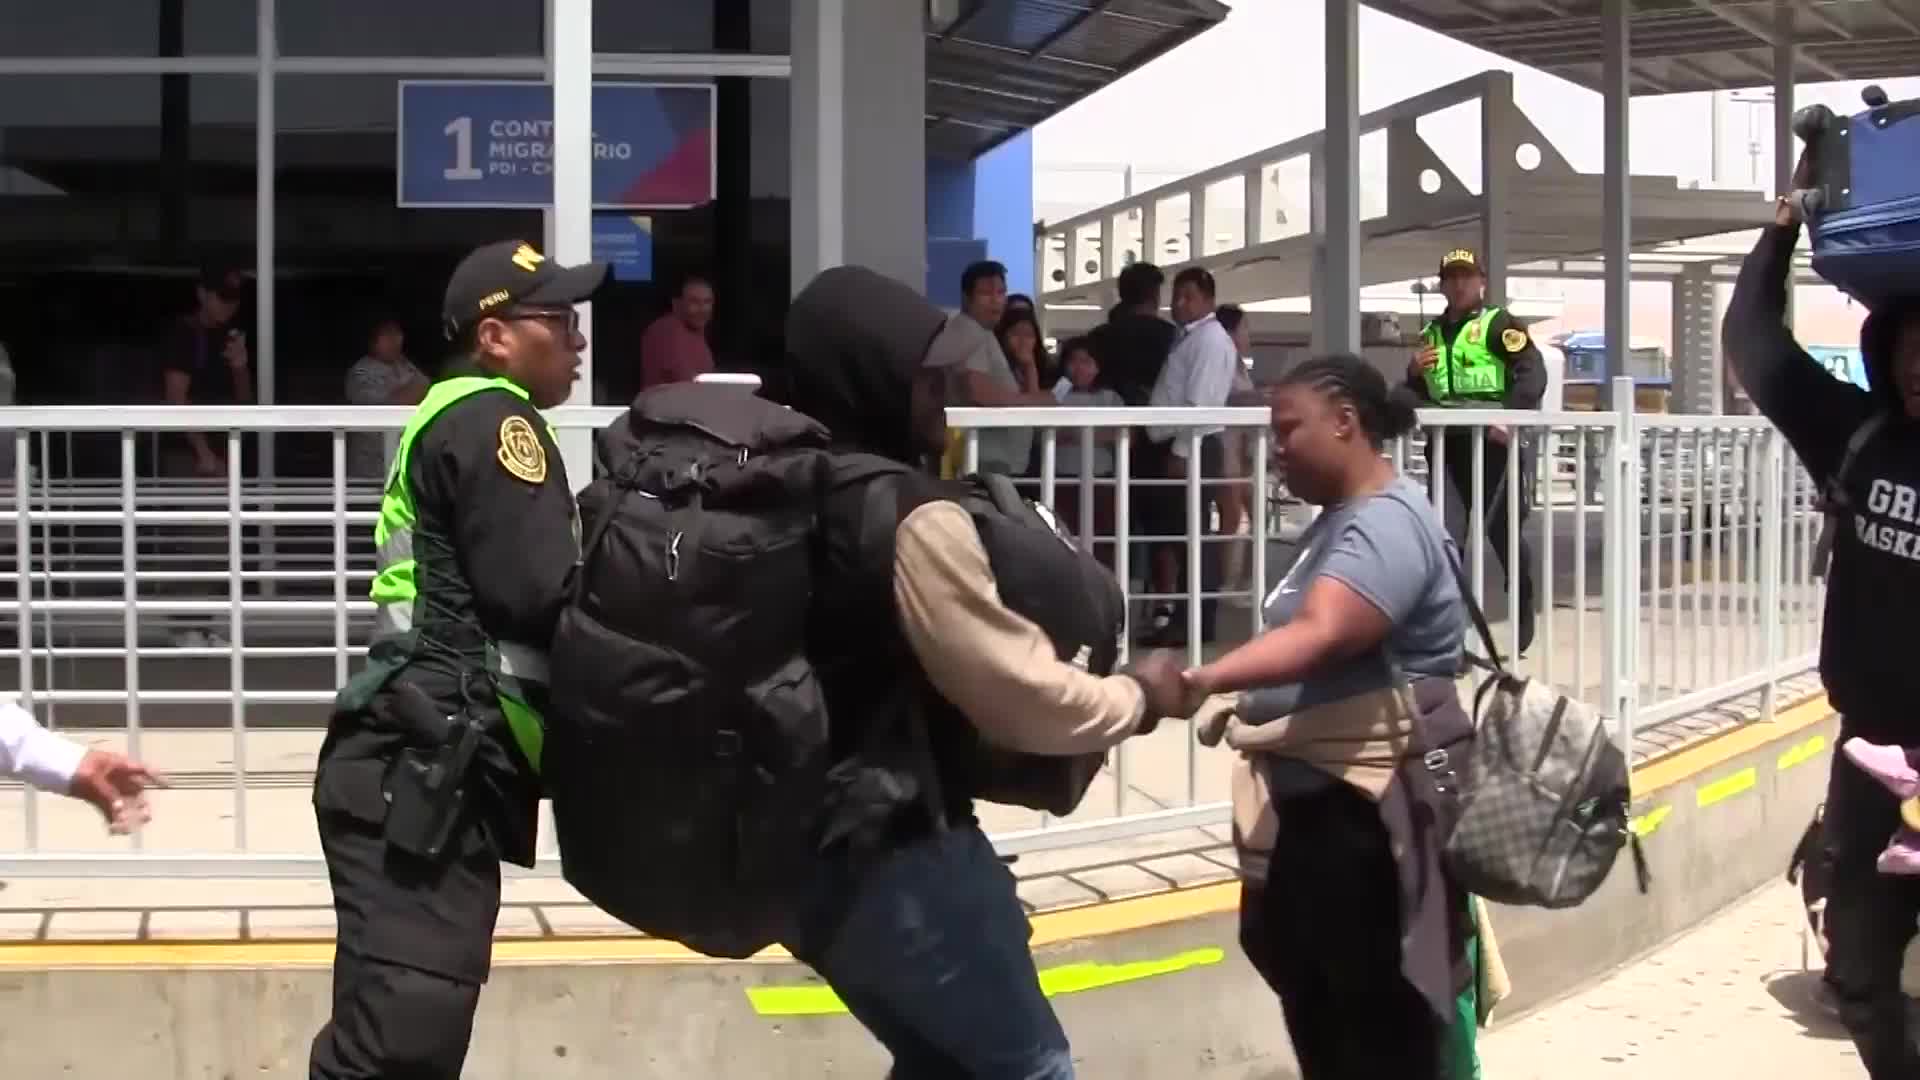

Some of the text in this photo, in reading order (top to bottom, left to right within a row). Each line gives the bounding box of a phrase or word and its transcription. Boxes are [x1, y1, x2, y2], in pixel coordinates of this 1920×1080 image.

[444, 116, 483, 180] 1
[489, 141, 632, 160] MIGRARIO
[489, 161, 516, 175] PDI
[1867, 479, 1920, 525] GR
